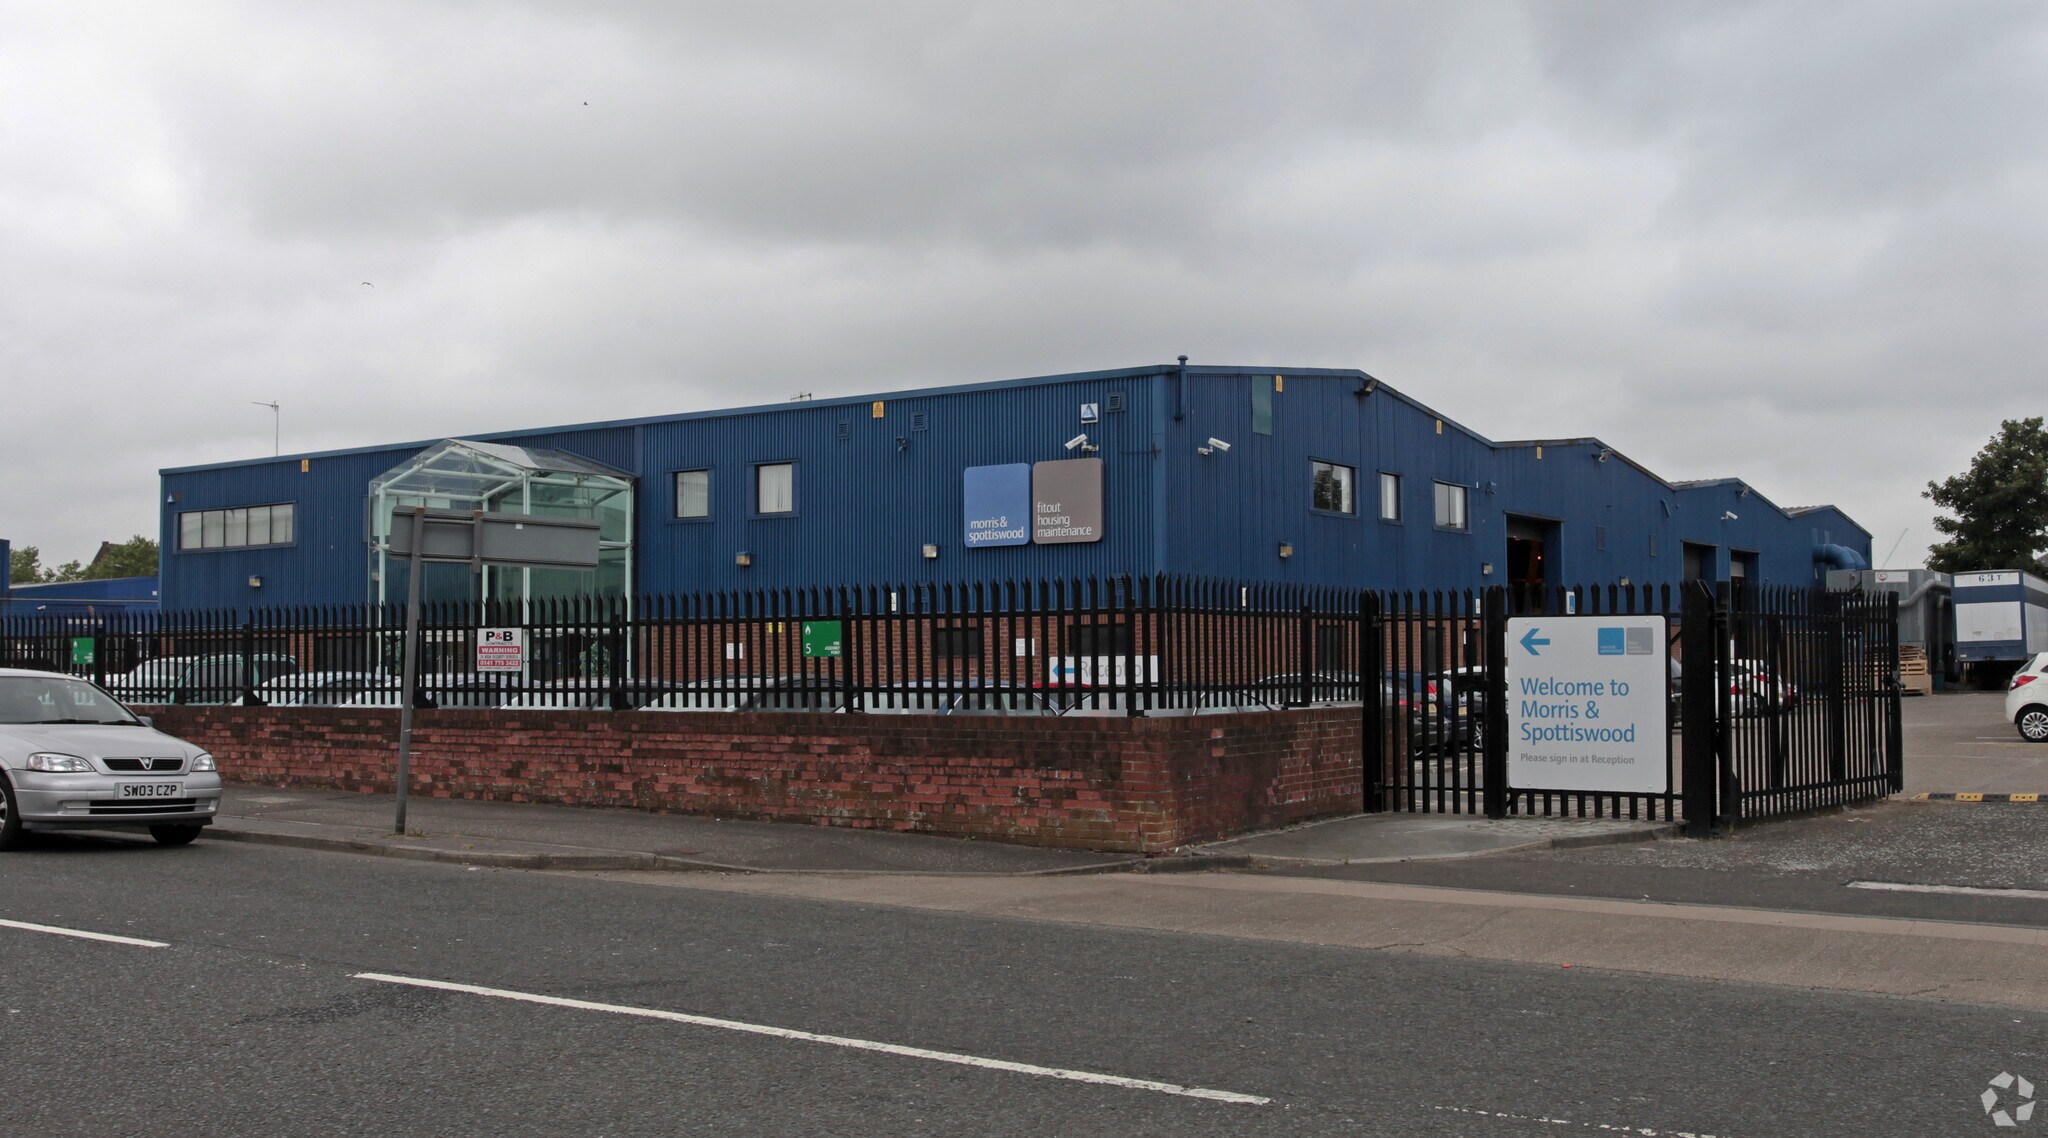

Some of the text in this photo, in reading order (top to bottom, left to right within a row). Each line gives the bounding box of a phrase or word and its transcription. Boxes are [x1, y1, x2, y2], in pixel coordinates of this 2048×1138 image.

[1037, 501, 1061, 513] fitout
[970, 515, 1008, 529] morris &
[1037, 514, 1070, 527] housing
[968, 526, 1024, 544] spottiswood
[1037, 525, 1092, 538] maintenance
[805, 643, 812, 654] 5
[1520, 676, 1630, 697] Welcome to
[1521, 700, 1600, 719] Morris &
[1520, 722, 1635, 746] Spottiswood
[1520, 753, 1635, 766] Please sign in at Reception
[123, 784, 177, 797] SW03 CZP
